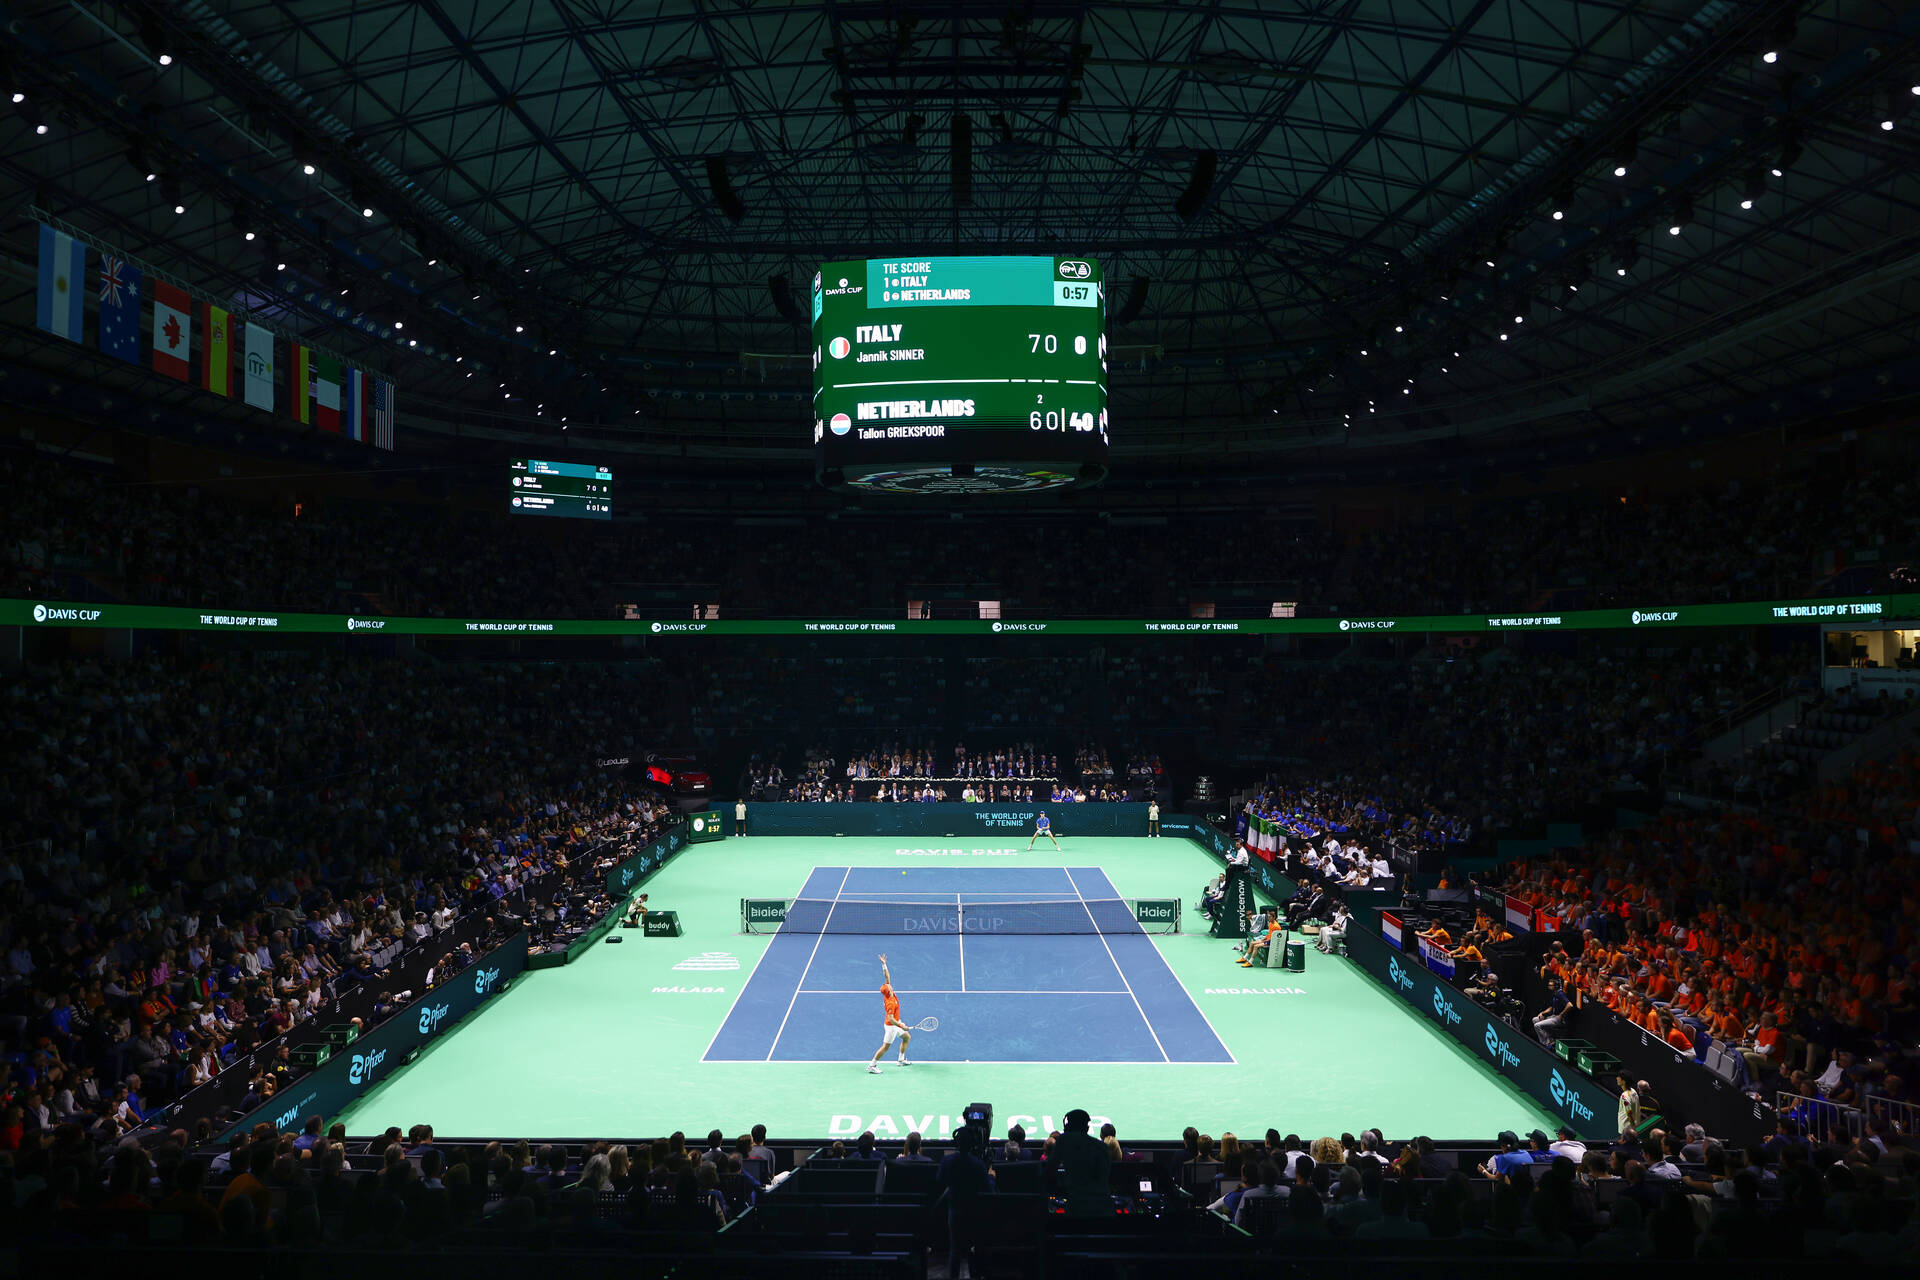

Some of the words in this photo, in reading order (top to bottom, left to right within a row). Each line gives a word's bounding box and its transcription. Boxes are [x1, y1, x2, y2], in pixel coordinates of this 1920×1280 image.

[883, 263, 898, 274] TIE
[900, 262, 932, 274] SCORE
[884, 277, 889, 288] 1
[901, 276, 928, 288] ITALY
[901, 289, 970, 301] NETHERLANDS
[1062, 286, 1088, 300] 0:57
[856, 324, 903, 344] ITALY
[1074, 336, 1086, 354] 0
[856, 350, 888, 363] Jannik
[890, 349, 924, 361] SINNER
[249, 359, 264, 375] ITF
[1037, 394, 1044, 404] 2
[857, 399, 975, 420] NETHERLANDS
[1070, 412, 1094, 432] 40
[858, 428, 886, 440] Tallon
[888, 426, 945, 438] GRIEKSPOOR
[48, 608, 78, 620] DAVIS
[78, 610, 100, 620] CUP
[1772, 608, 1788, 617] THE
[1788, 606, 1818, 616] WORLD
[1818, 604, 1836, 616] CUP
[1836, 604, 1848, 614] OF
[1850, 603, 1882, 614] TENNIS
[200, 616, 212, 624] THE
[214, 616, 236, 625] WORLD
[236, 616, 248, 626] CUP
[248, 618, 256, 626] OF
[258, 618, 278, 626] TENNIS
[1522, 618, 1534, 626] CUP
[1542, 616, 1562, 625] TENNIS
[1642, 612, 1662, 622] DAVIS
[1662, 612, 1678, 620] CUP
[356, 620, 372, 628] DAVIS
[372, 620, 384, 628] CUP
[1140, 906, 1172, 917] Haier
[1236, 879, 1246, 932] servicenow
[904, 918, 958, 931] DAVIS
[964, 918, 1004, 930] CUP
